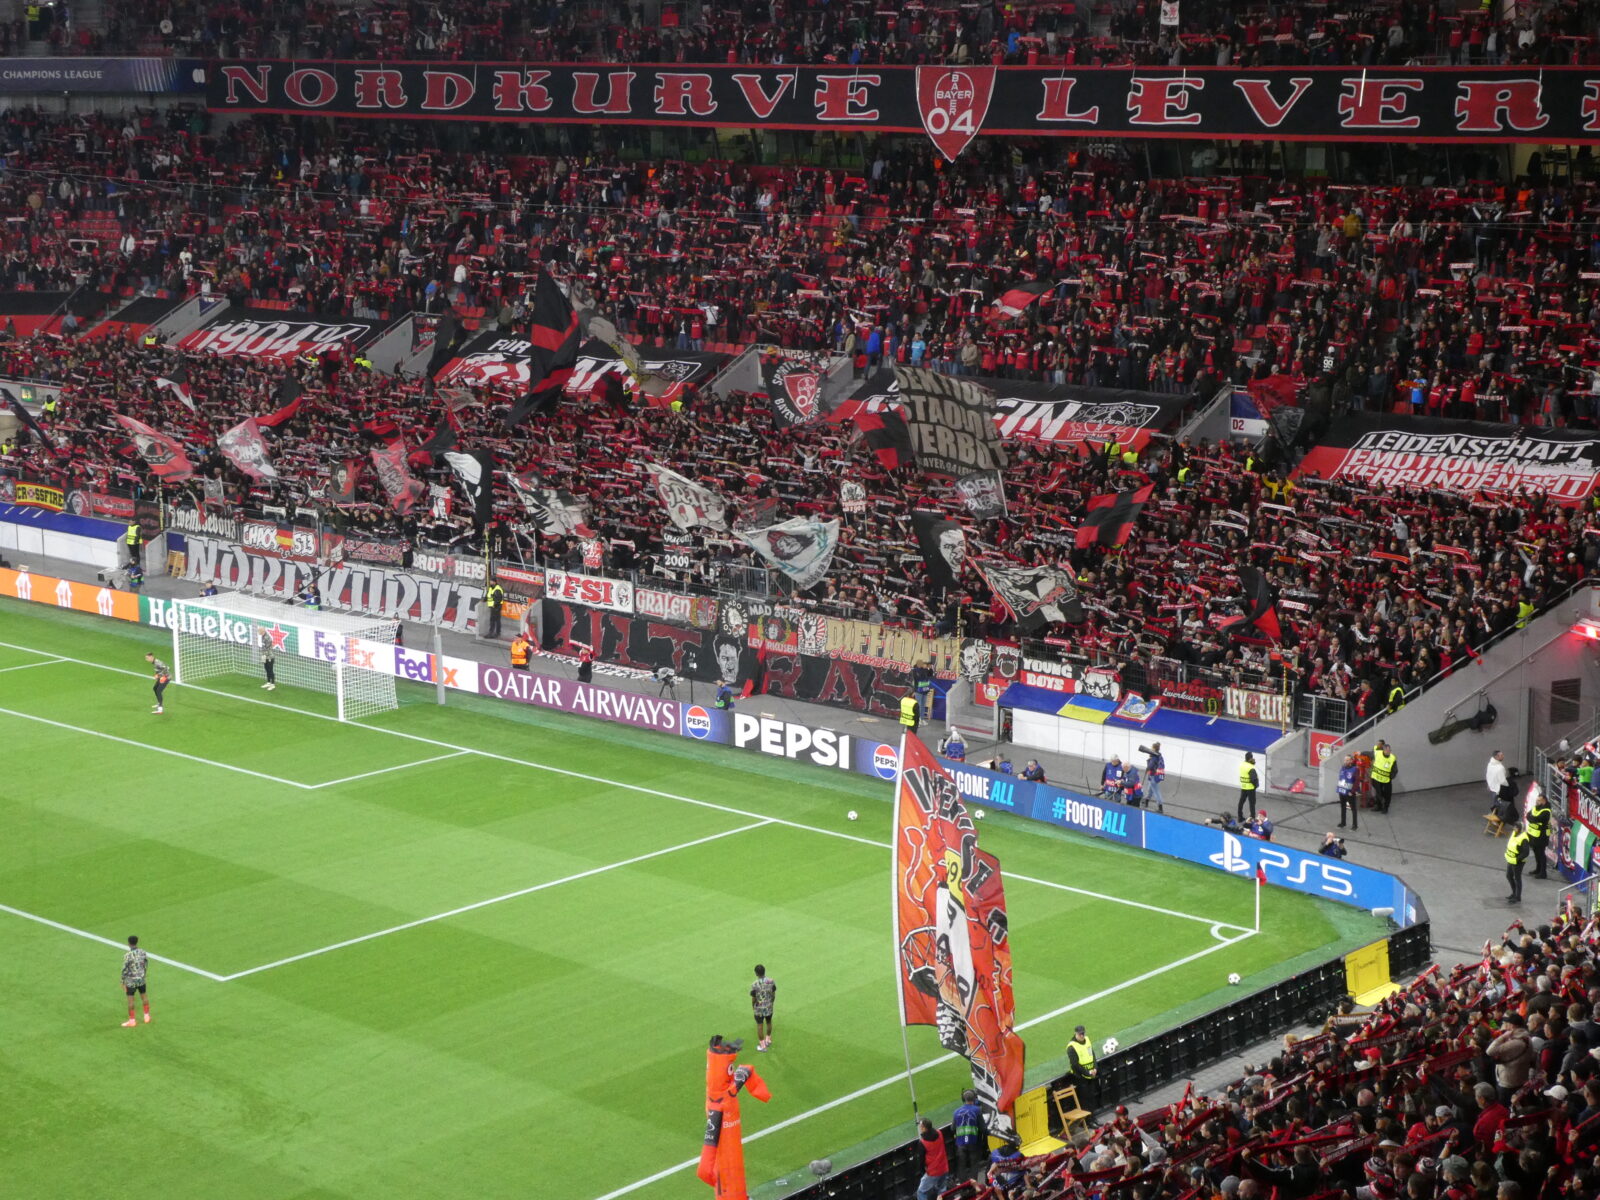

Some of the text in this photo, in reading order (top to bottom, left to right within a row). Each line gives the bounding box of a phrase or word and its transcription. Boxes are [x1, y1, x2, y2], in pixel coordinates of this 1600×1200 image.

[3, 70, 103, 80] CHAMPIONS LEAGUE
[220, 63, 1600, 134] NORDKURVE LEVER
[926, 107, 977, 136] 04
[488, 338, 532, 354] FÜR
[1232, 419, 1244, 431] D2
[1360, 432, 1594, 462] LEIDENSCHAFT
[1349, 448, 1532, 475] EMOTIONEN
[292, 532, 317, 557] 513
[664, 554, 690, 569] 2009
[562, 576, 614, 606] FSI
[749, 604, 772, 616] MAD
[747, 637, 798, 656] LEVRKUSEN
[1023, 658, 1072, 679] YOUNG
[1026, 673, 1065, 691] BOYS
[484, 668, 675, 733] QATAR AIRWAYS
[1226, 687, 1248, 716] LEV
[686, 716, 711, 729] PEPSI
[734, 713, 850, 770] PEPSI
[875, 756, 898, 768] PEPSI
[990, 780, 1015, 807] ALL
[1052, 796, 1128, 838] #FOOTBALL
[1259, 847, 1354, 898] PS5
